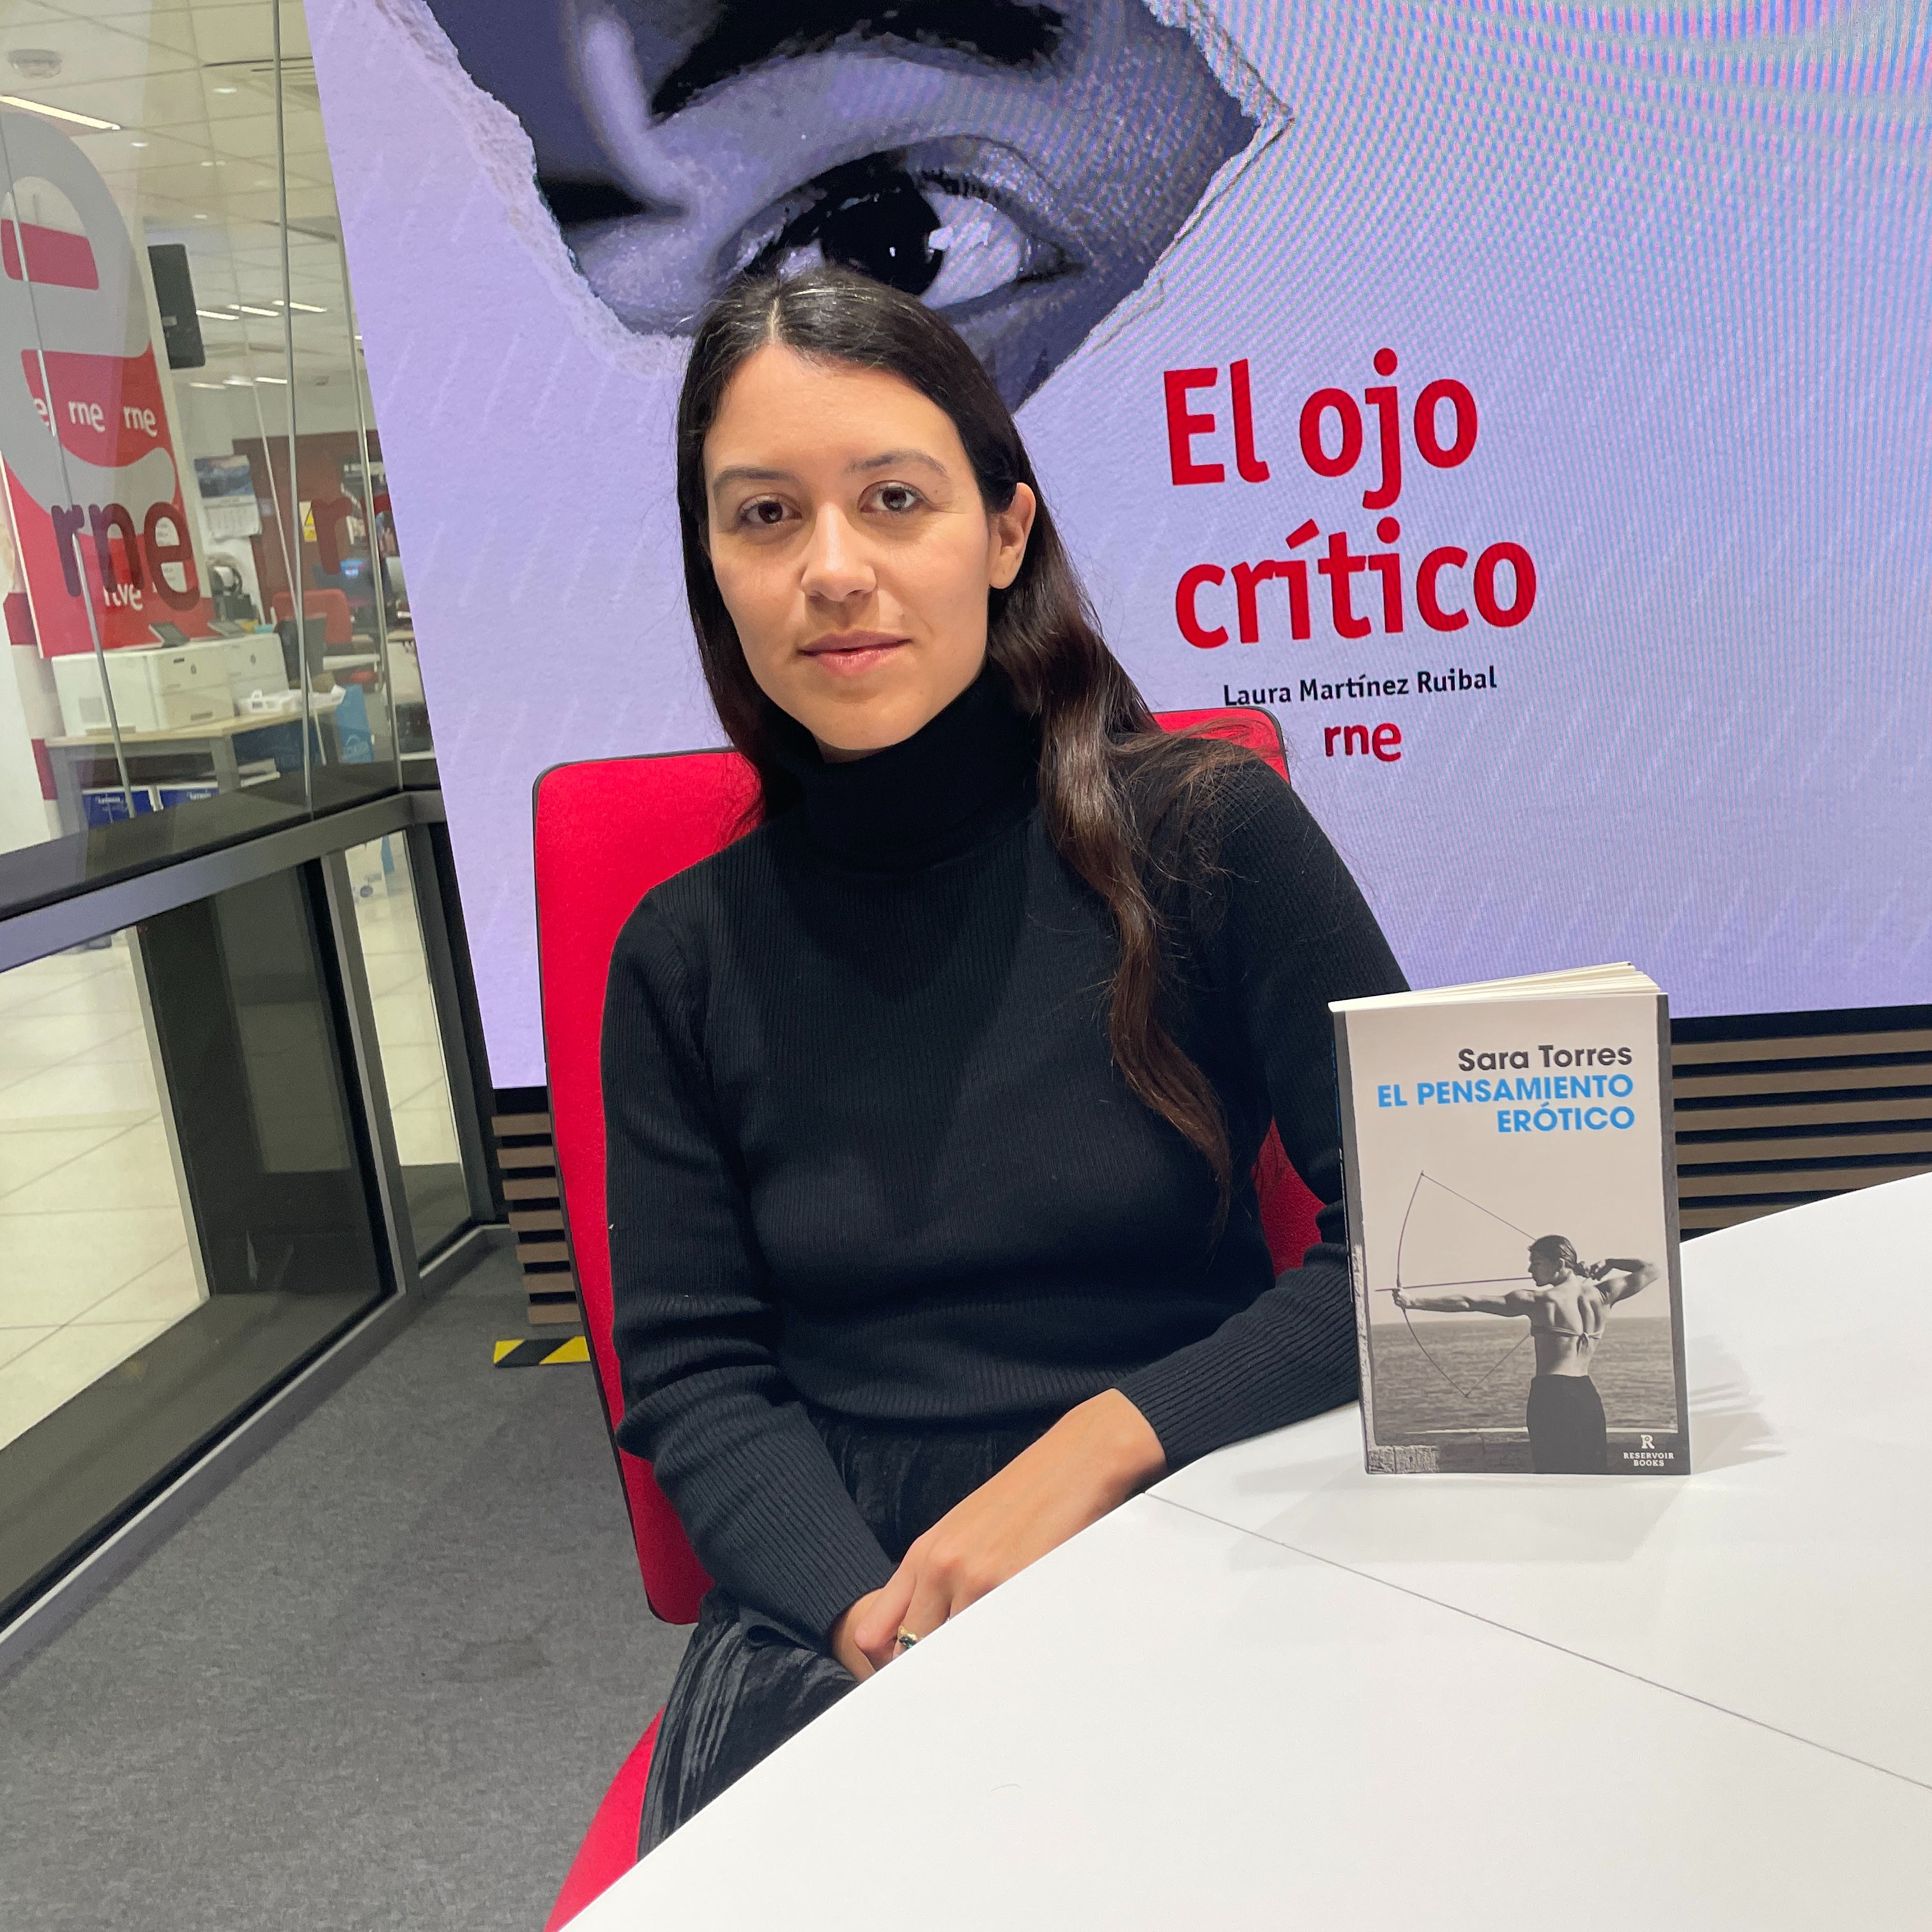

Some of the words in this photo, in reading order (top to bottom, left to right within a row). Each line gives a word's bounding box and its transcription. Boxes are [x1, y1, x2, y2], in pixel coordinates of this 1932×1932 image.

[68, 401, 105, 433] rne
[123, 406, 158, 436] rne
[1163, 358, 1270, 486] El
[1300, 348, 1478, 510] ojo
[51, 502, 200, 611] rne
[1176, 518, 1537, 649] crítico
[1223, 684, 1291, 706] Laura
[1300, 673, 1409, 702] Martínez
[1417, 665, 1498, 694] Ruibal
[1324, 722, 1402, 762] rne
[1458, 1048, 1529, 1071] Sara
[1538, 1045, 1632, 1068] Torres
[1377, 1084, 1408, 1107] EL
[1417, 1074, 1634, 1105] PENSAMIENTO
[1497, 1102, 1635, 1133] ERÓTICO
[1640, 1434, 1655, 1449] R
